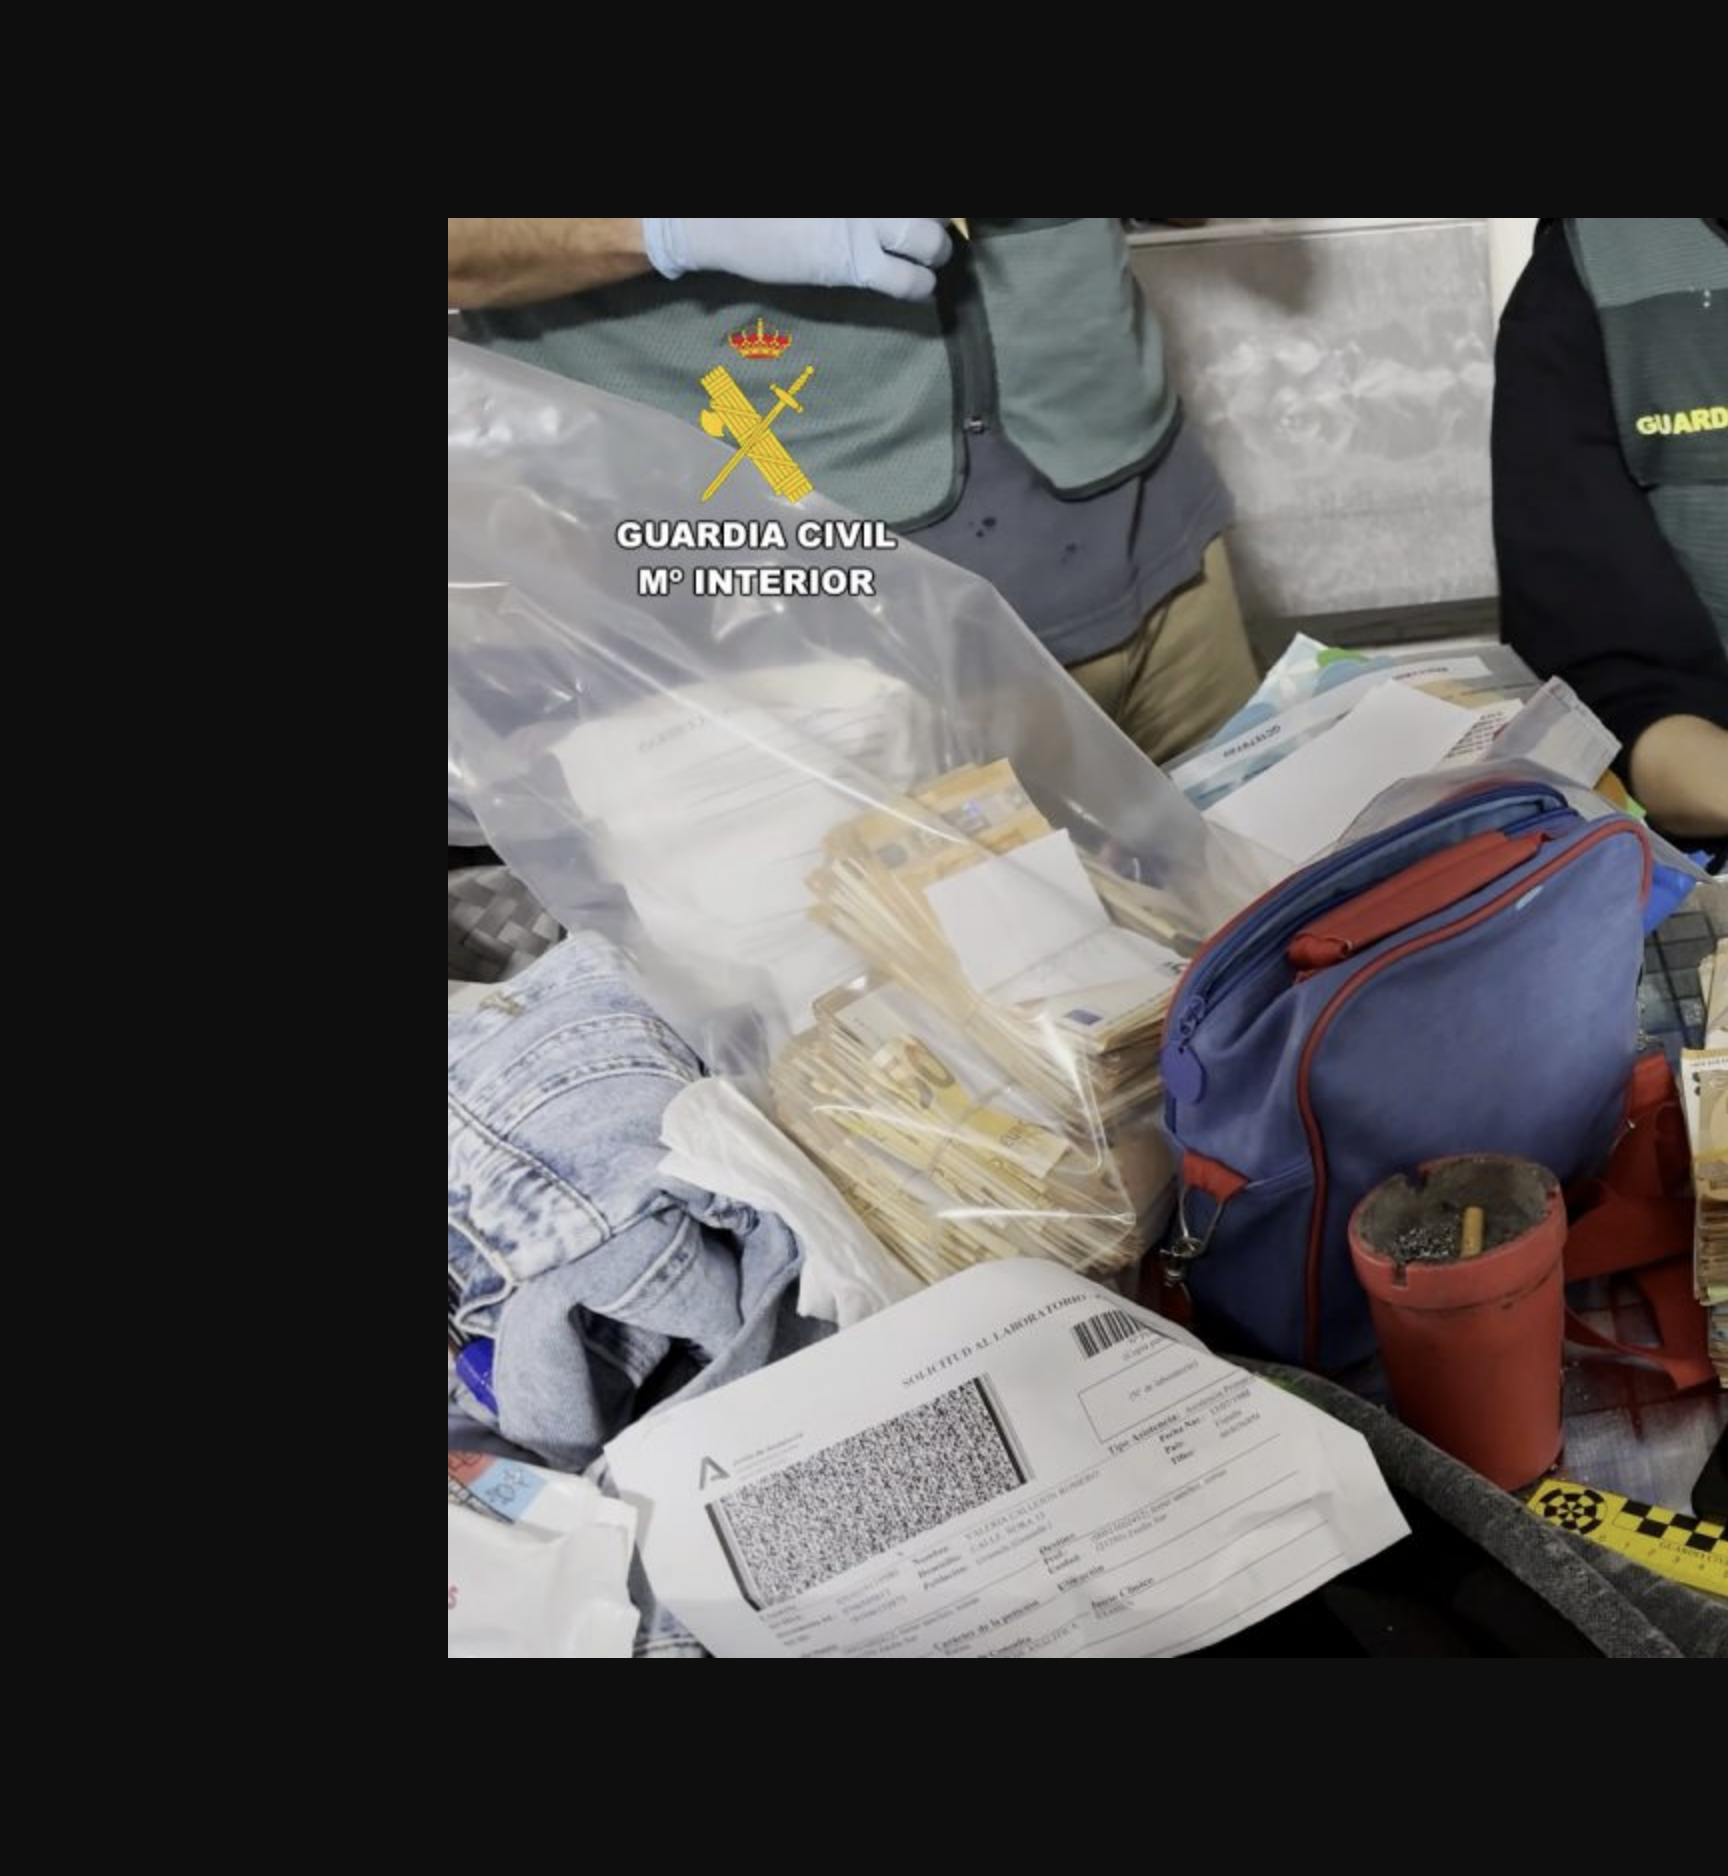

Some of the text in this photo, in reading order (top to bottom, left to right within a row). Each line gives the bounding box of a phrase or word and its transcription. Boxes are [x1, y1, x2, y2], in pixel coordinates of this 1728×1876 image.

[902, 1294, 1087, 1387] SOLICITUD AL LABORATORIO
